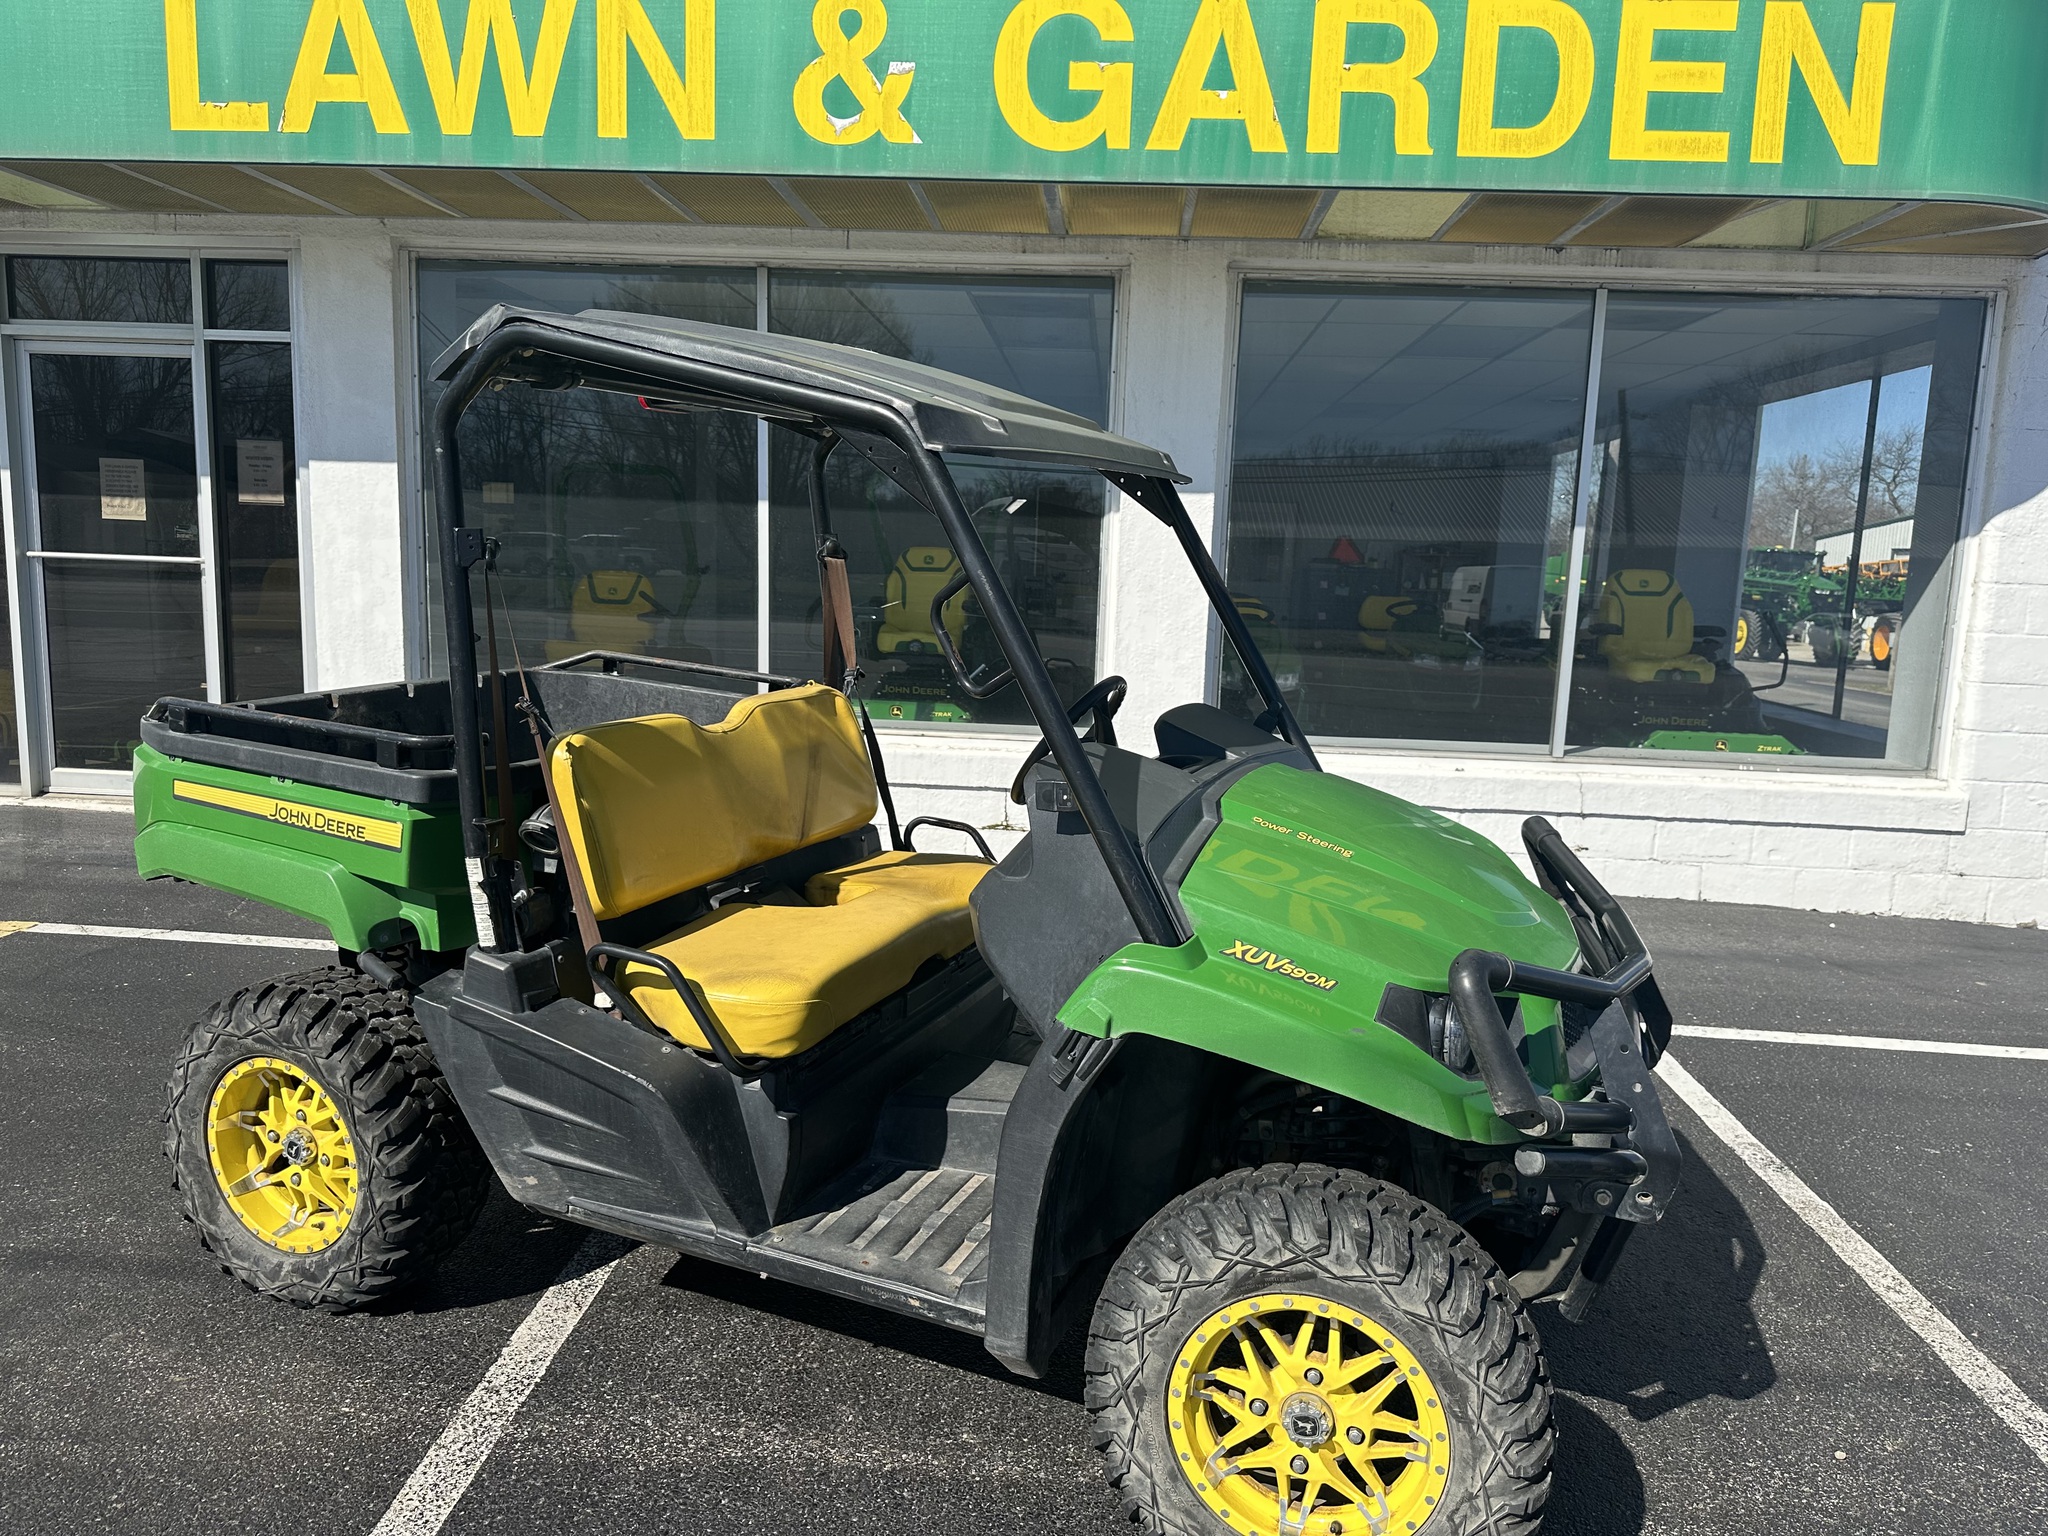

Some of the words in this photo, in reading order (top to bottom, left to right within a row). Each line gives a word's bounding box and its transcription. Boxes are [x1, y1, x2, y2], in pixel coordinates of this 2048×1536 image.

[167, 0, 715, 140] LAWN
[793, 0, 923, 145] &
[994, 0, 1896, 166] GARDEN
[881, 685, 910, 694] JOHN
[912, 686, 947, 696] DEERE
[1638, 715, 1669, 725] JOHN
[1671, 716, 1709, 726] DEERE
[269, 803, 311, 826] JOHN
[314, 812, 366, 839] DEERE
[1253, 816, 1293, 834] Power
[1296, 831, 1353, 858] Steering
[1221, 939, 1338, 991] XUV590M
